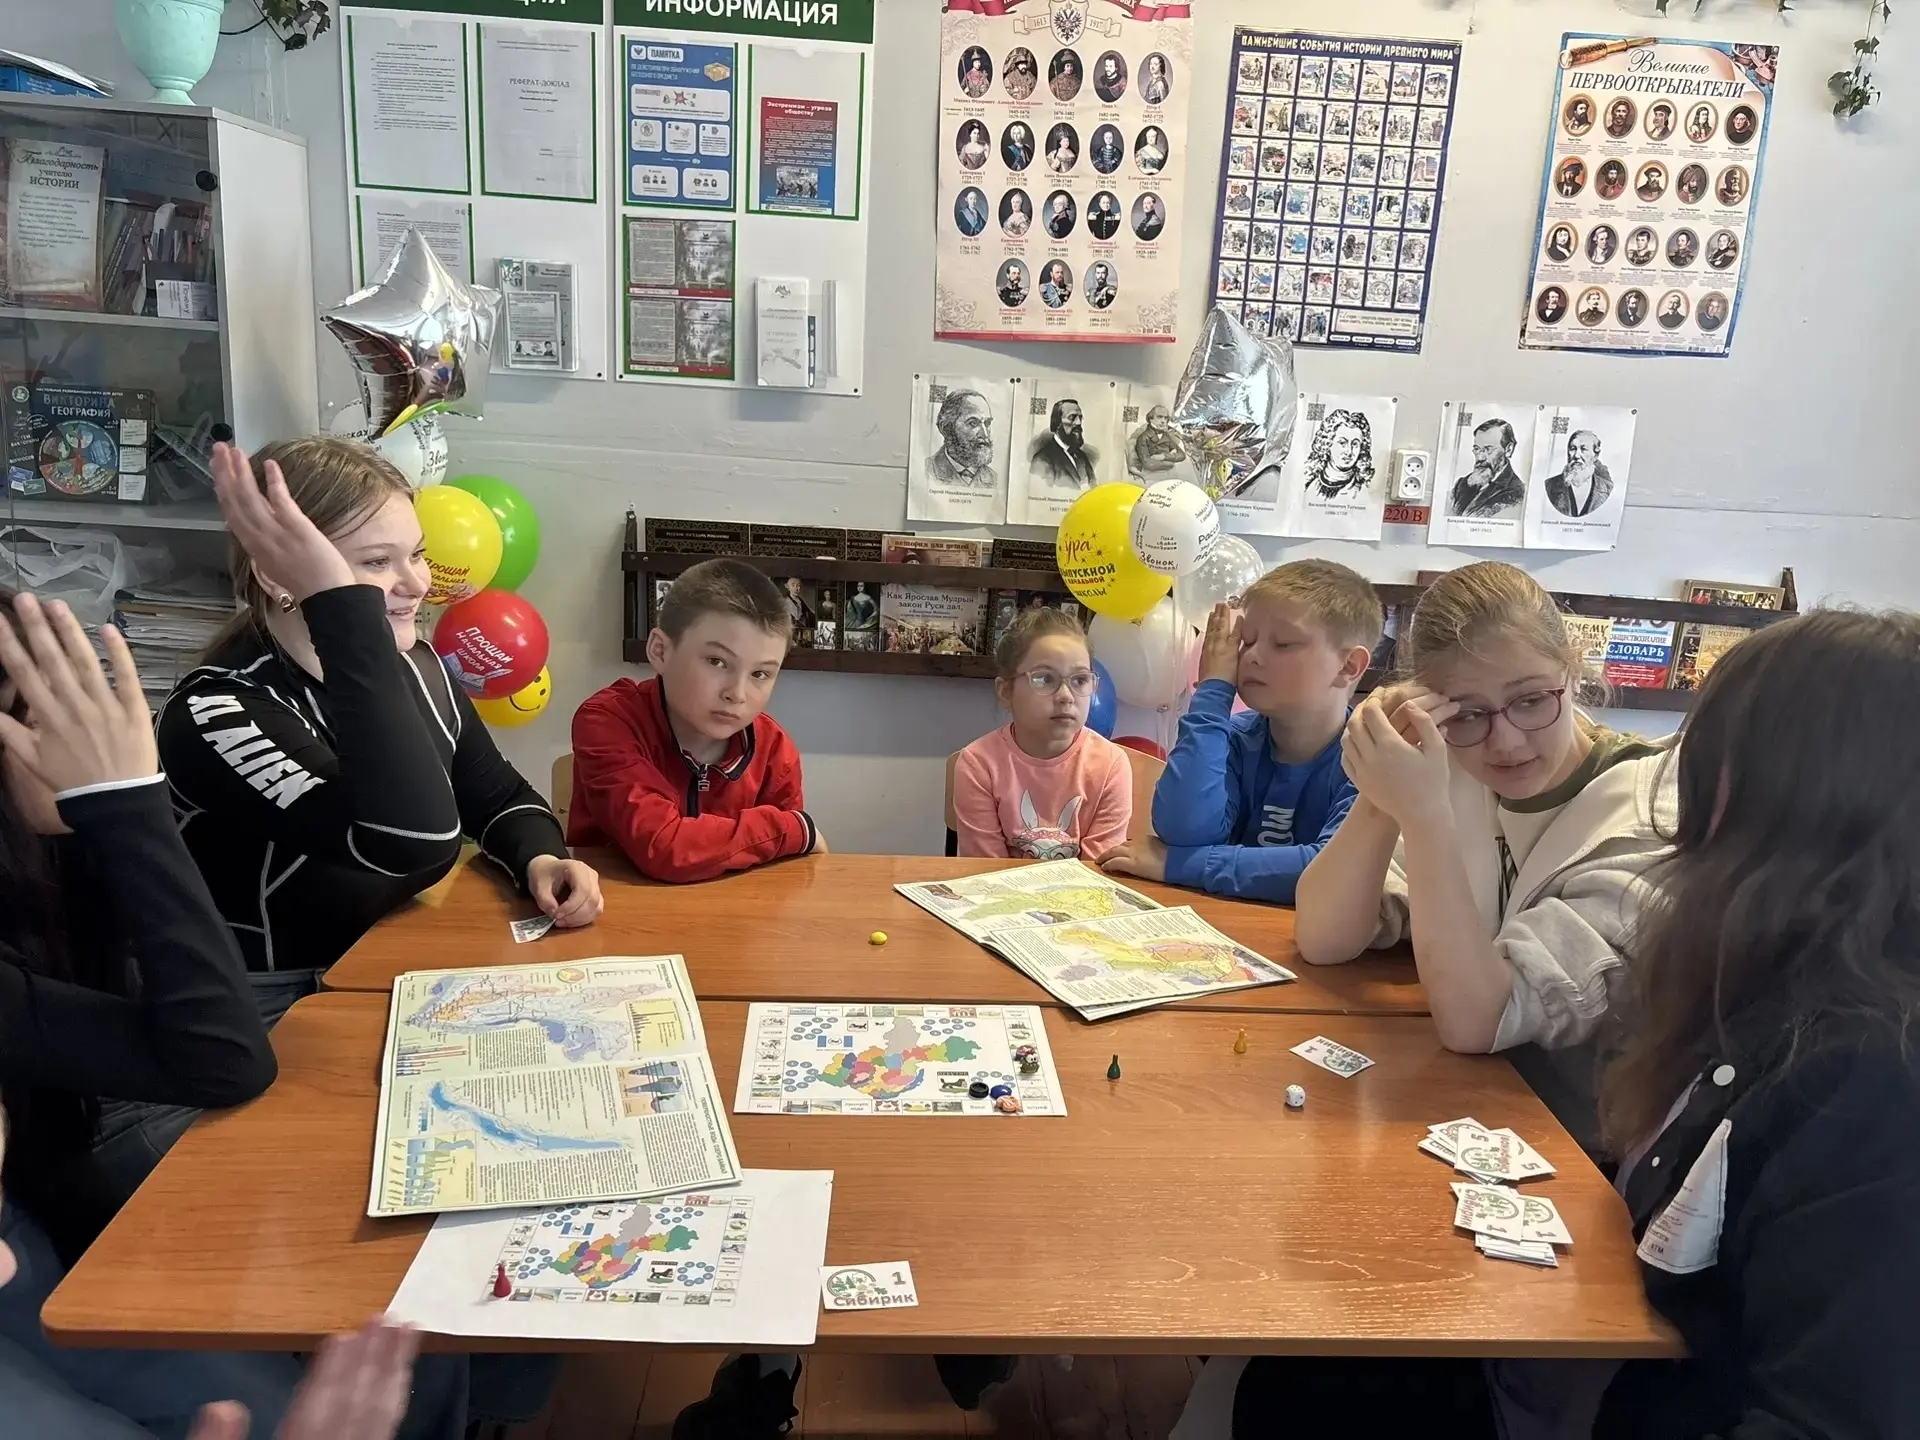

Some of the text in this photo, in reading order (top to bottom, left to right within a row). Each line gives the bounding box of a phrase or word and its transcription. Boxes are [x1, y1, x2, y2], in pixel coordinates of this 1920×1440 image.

[1033, 17, 1047, 27] 1613
[650, 48, 681, 60] ПАМЯТКА
[1300, 38, 1340, 52] СОБЫТИЯ
[1342, 41, 1382, 56] ИСТОРИИ
[1384, 44, 1428, 60] ДРЕВНЕГО
[1430, 48, 1454, 60] МИРА
[1628, 49, 1710, 75] Великие
[1569, 72, 1746, 98] ПЕРВООТКРЫВАТЕЛИ
[17, 149, 99, 171] Благодарность
[39, 169, 72, 178] учителю
[30, 176, 80, 189] ИСТОРИИ
[44, 394, 116, 408] ВИКТОРИНА
[51, 406, 111, 418] ГЕОГРАФИЯ
[1384, 507, 1423, 522] 220 В
[1140, 551, 1174, 566] Звонок
[432, 572, 466, 584] ЧАЛЬНАЯ
[886, 592, 902, 600] Как
[904, 592, 939, 602] Ярослав
[925, 602, 944, 611] Руси
[946, 603, 964, 611] дал,
[466, 626, 514, 664] ПРОЩАЙ
[1609, 633, 1666, 644] ОБЩЕСТВОЗНАНИЕ
[456, 632, 502, 669] НАЧАЛЬНАЯ
[1607, 644, 1664, 657] СЛОВАРЬ
[456, 648, 485, 672] ШКОЛА
[201, 720, 327, 810] ALIEN
[1316, 1038, 1368, 1064] Сибирик
[1470, 1132, 1489, 1142] 5
[1521, 1162, 1541, 1170] 5
[1460, 1189, 1480, 1227] Сибирик
[1486, 1224, 1507, 1233] 1
[892, 1272, 906, 1285] 1
[834, 1294, 915, 1306] Сибирик
